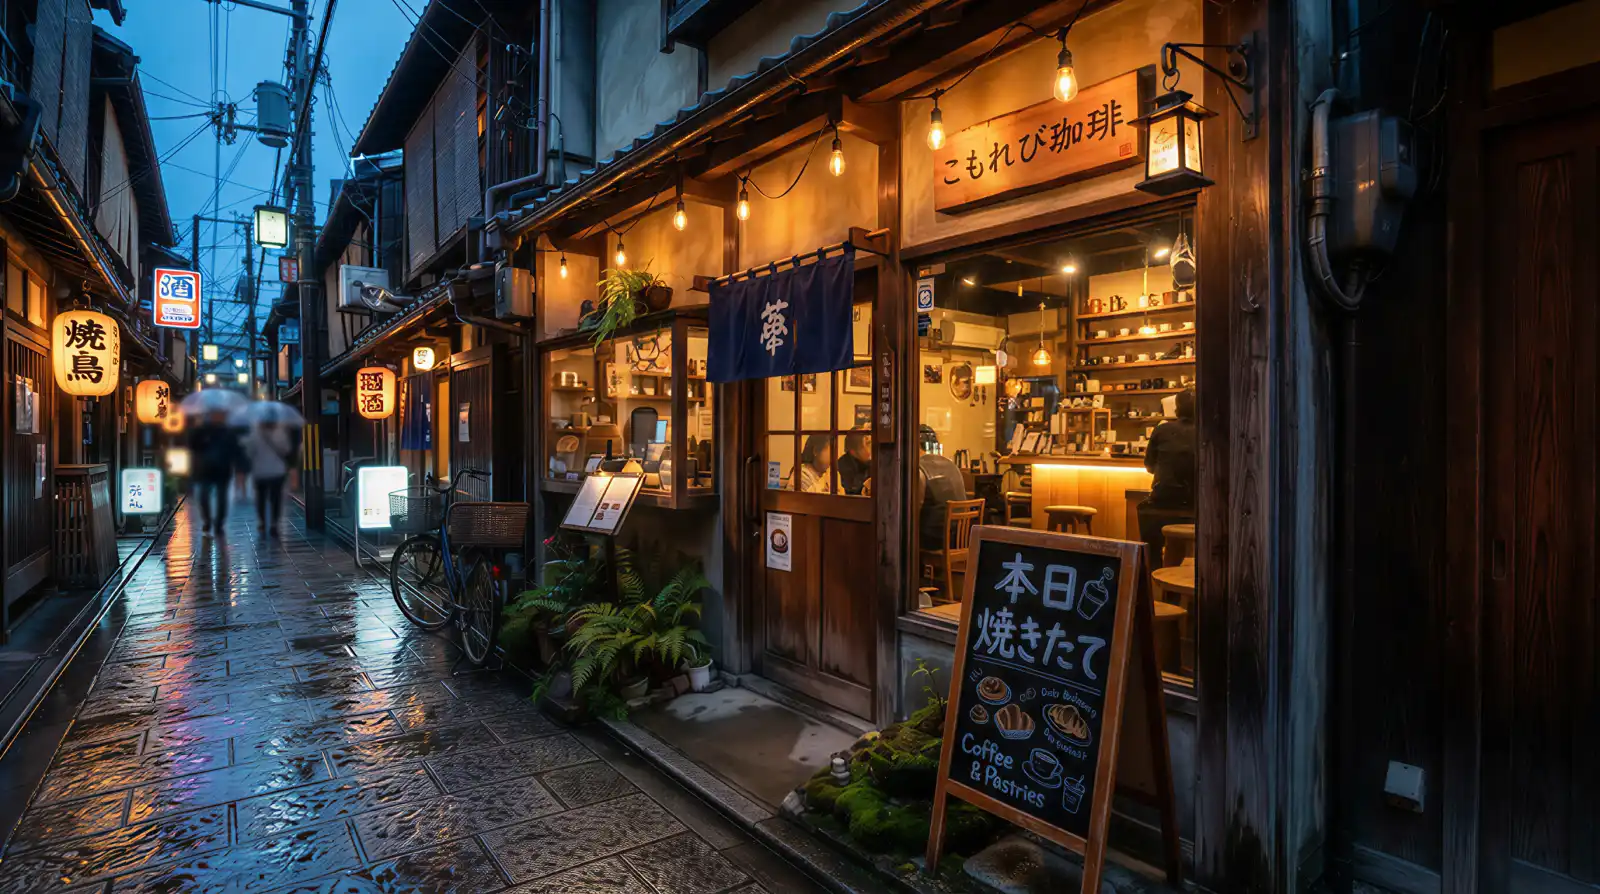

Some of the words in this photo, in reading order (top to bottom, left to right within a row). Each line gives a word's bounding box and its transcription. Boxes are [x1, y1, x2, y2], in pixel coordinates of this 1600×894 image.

[944, 100, 1124, 185] こもれび珈琲
[161, 275, 193, 299] 酒
[65, 319, 106, 383] 焼鳥
[994, 552, 1077, 611] 本日
[973, 607, 1106, 680] 焼きたて
[962, 732, 1014, 769] Coffee
[970, 760, 981, 781] &
[984, 764, 1045, 809] Pastries
